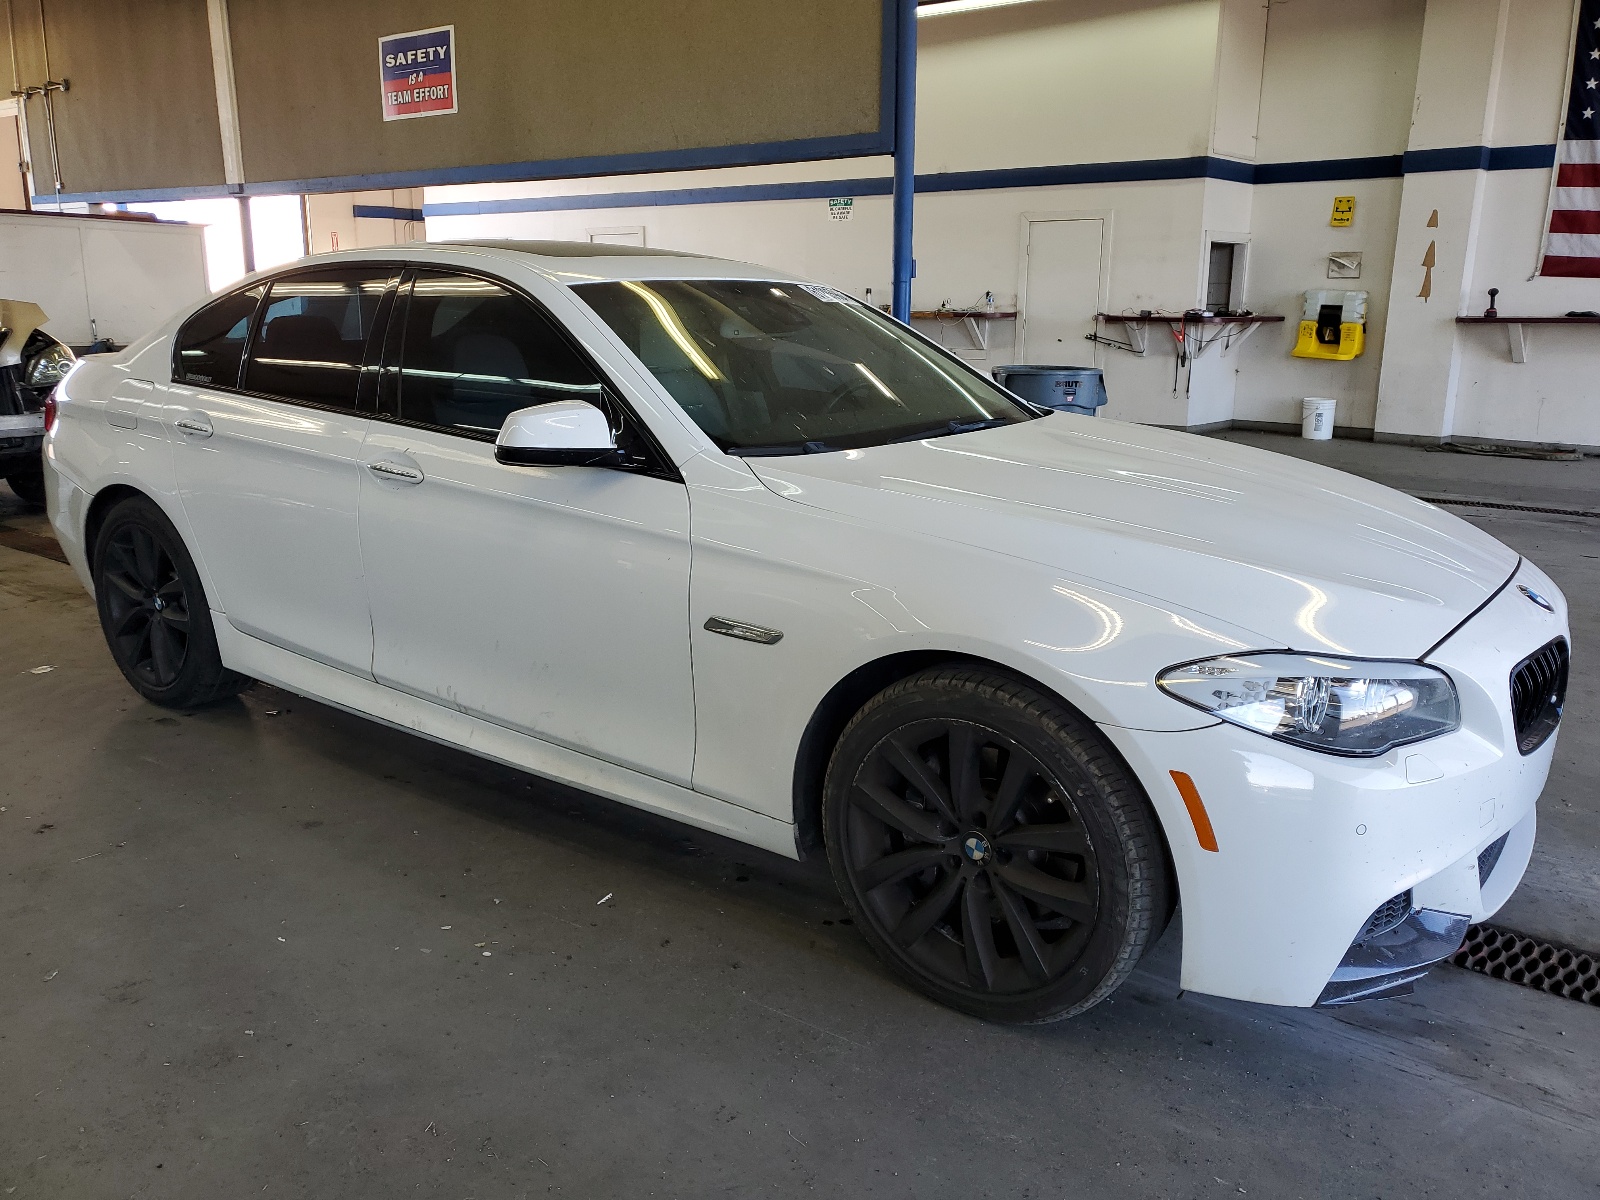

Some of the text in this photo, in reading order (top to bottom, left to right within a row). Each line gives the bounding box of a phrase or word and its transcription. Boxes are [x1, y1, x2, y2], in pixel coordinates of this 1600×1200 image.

[385, 45, 447, 68] SAFETY
[408, 71, 424, 86] IS A
[387, 84, 449, 106] TEAM EFFORT
